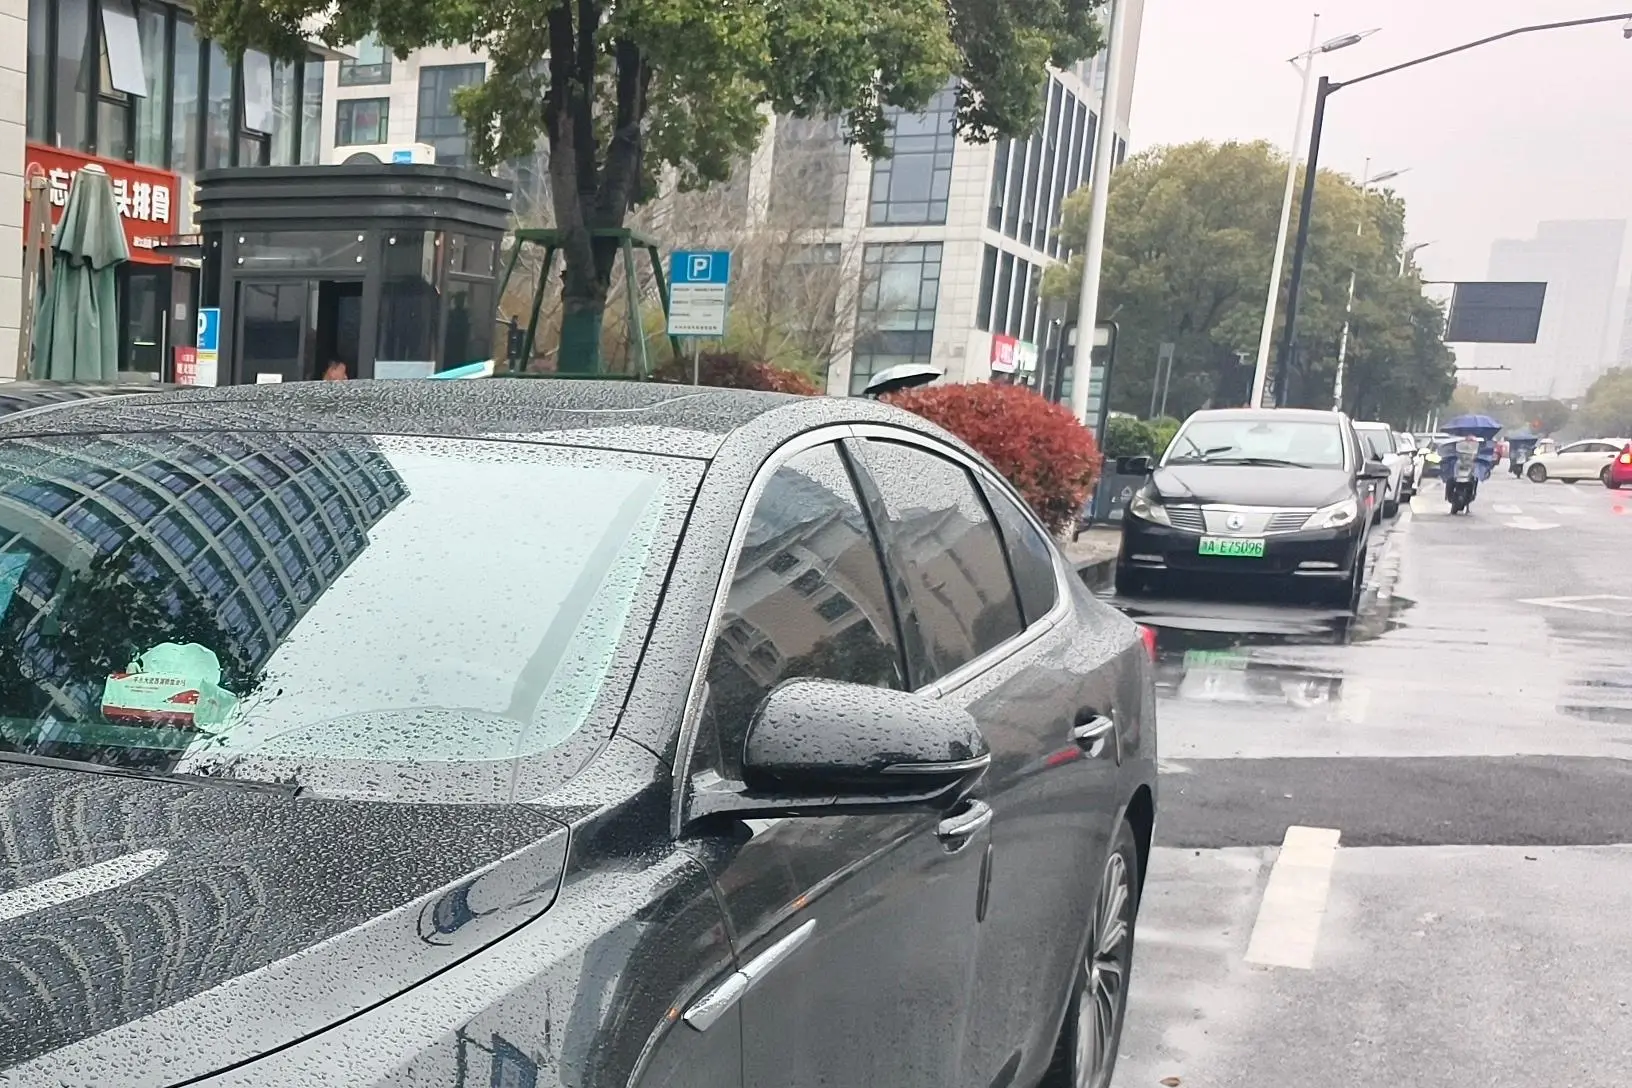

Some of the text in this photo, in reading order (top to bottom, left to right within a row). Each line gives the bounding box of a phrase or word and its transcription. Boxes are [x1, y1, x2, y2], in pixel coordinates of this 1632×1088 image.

[48, 167, 170, 224] 忘头排骨
[693, 258, 708, 277] P
